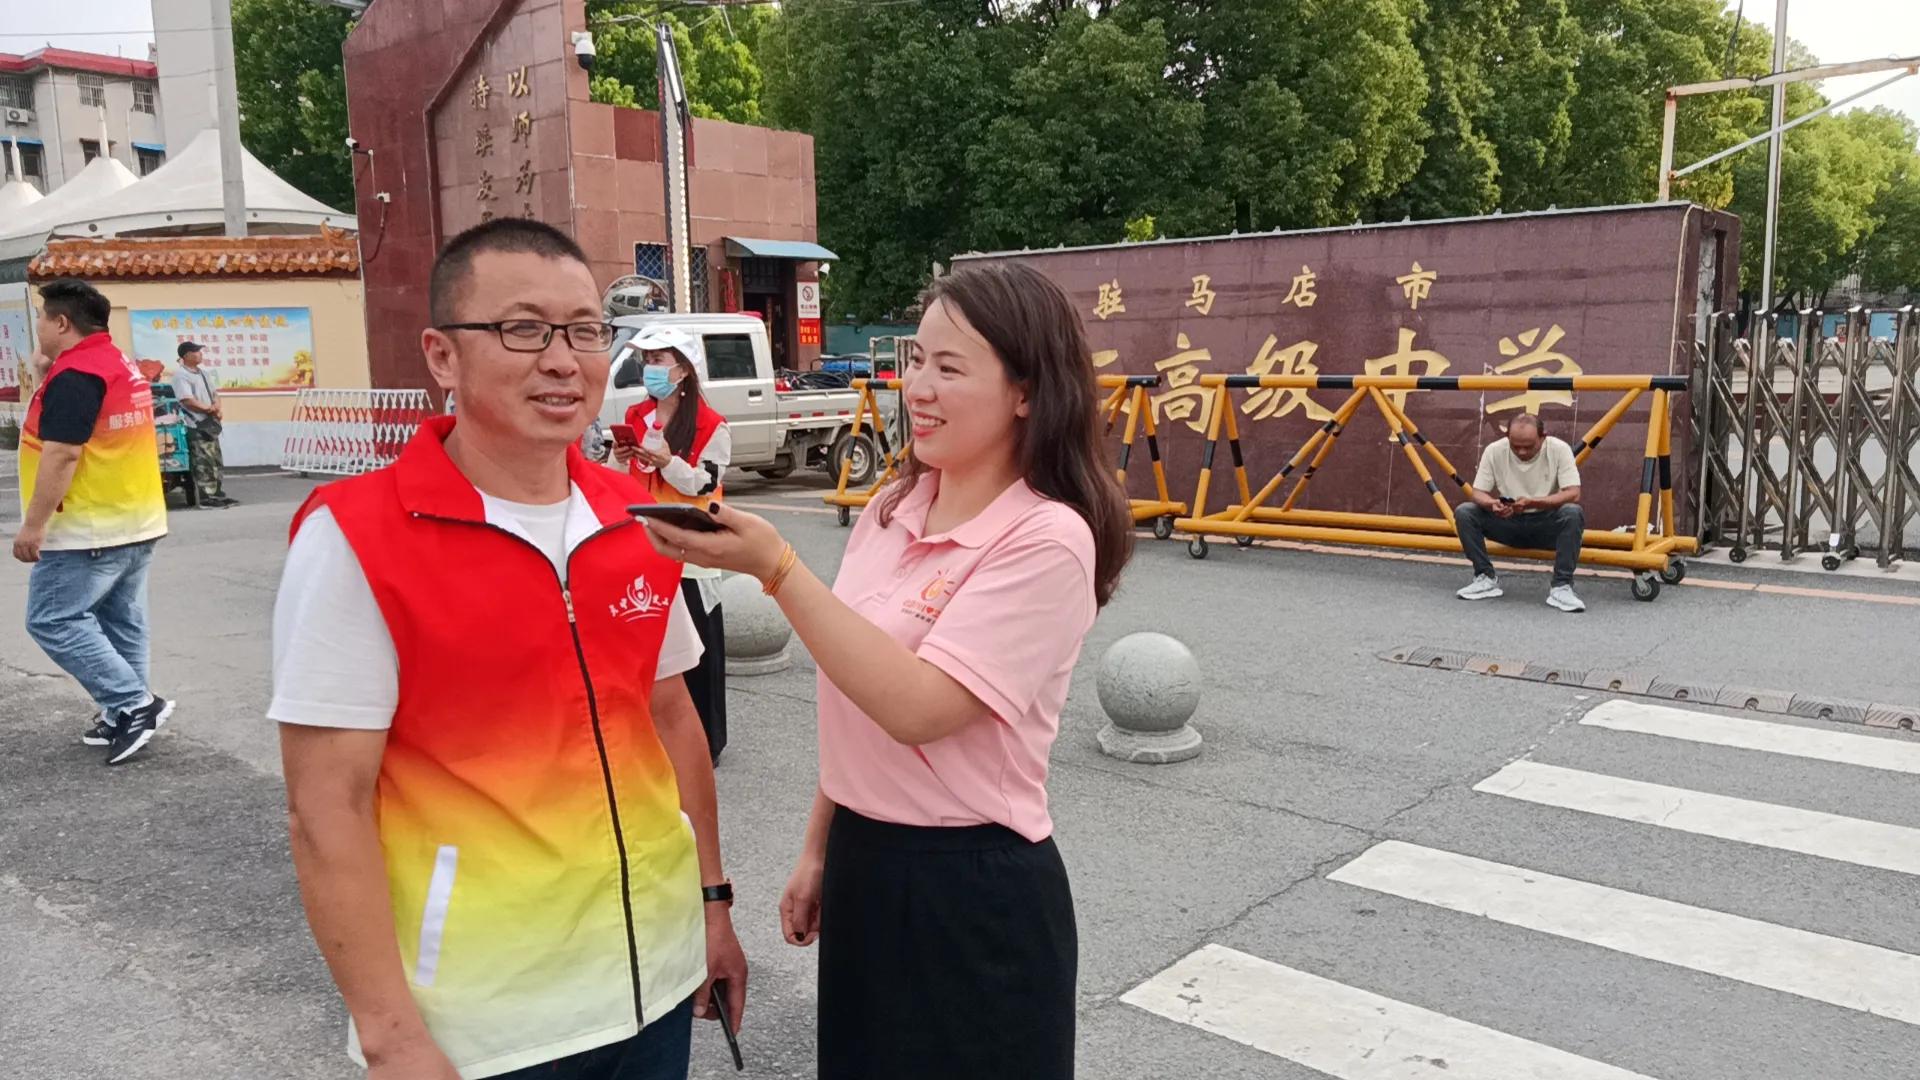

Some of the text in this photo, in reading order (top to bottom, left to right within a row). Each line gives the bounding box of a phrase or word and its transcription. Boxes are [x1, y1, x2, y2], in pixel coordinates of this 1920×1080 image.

[1092, 260, 1438, 320] 驻马店市
[1092, 323, 1583, 443] 高级中学
